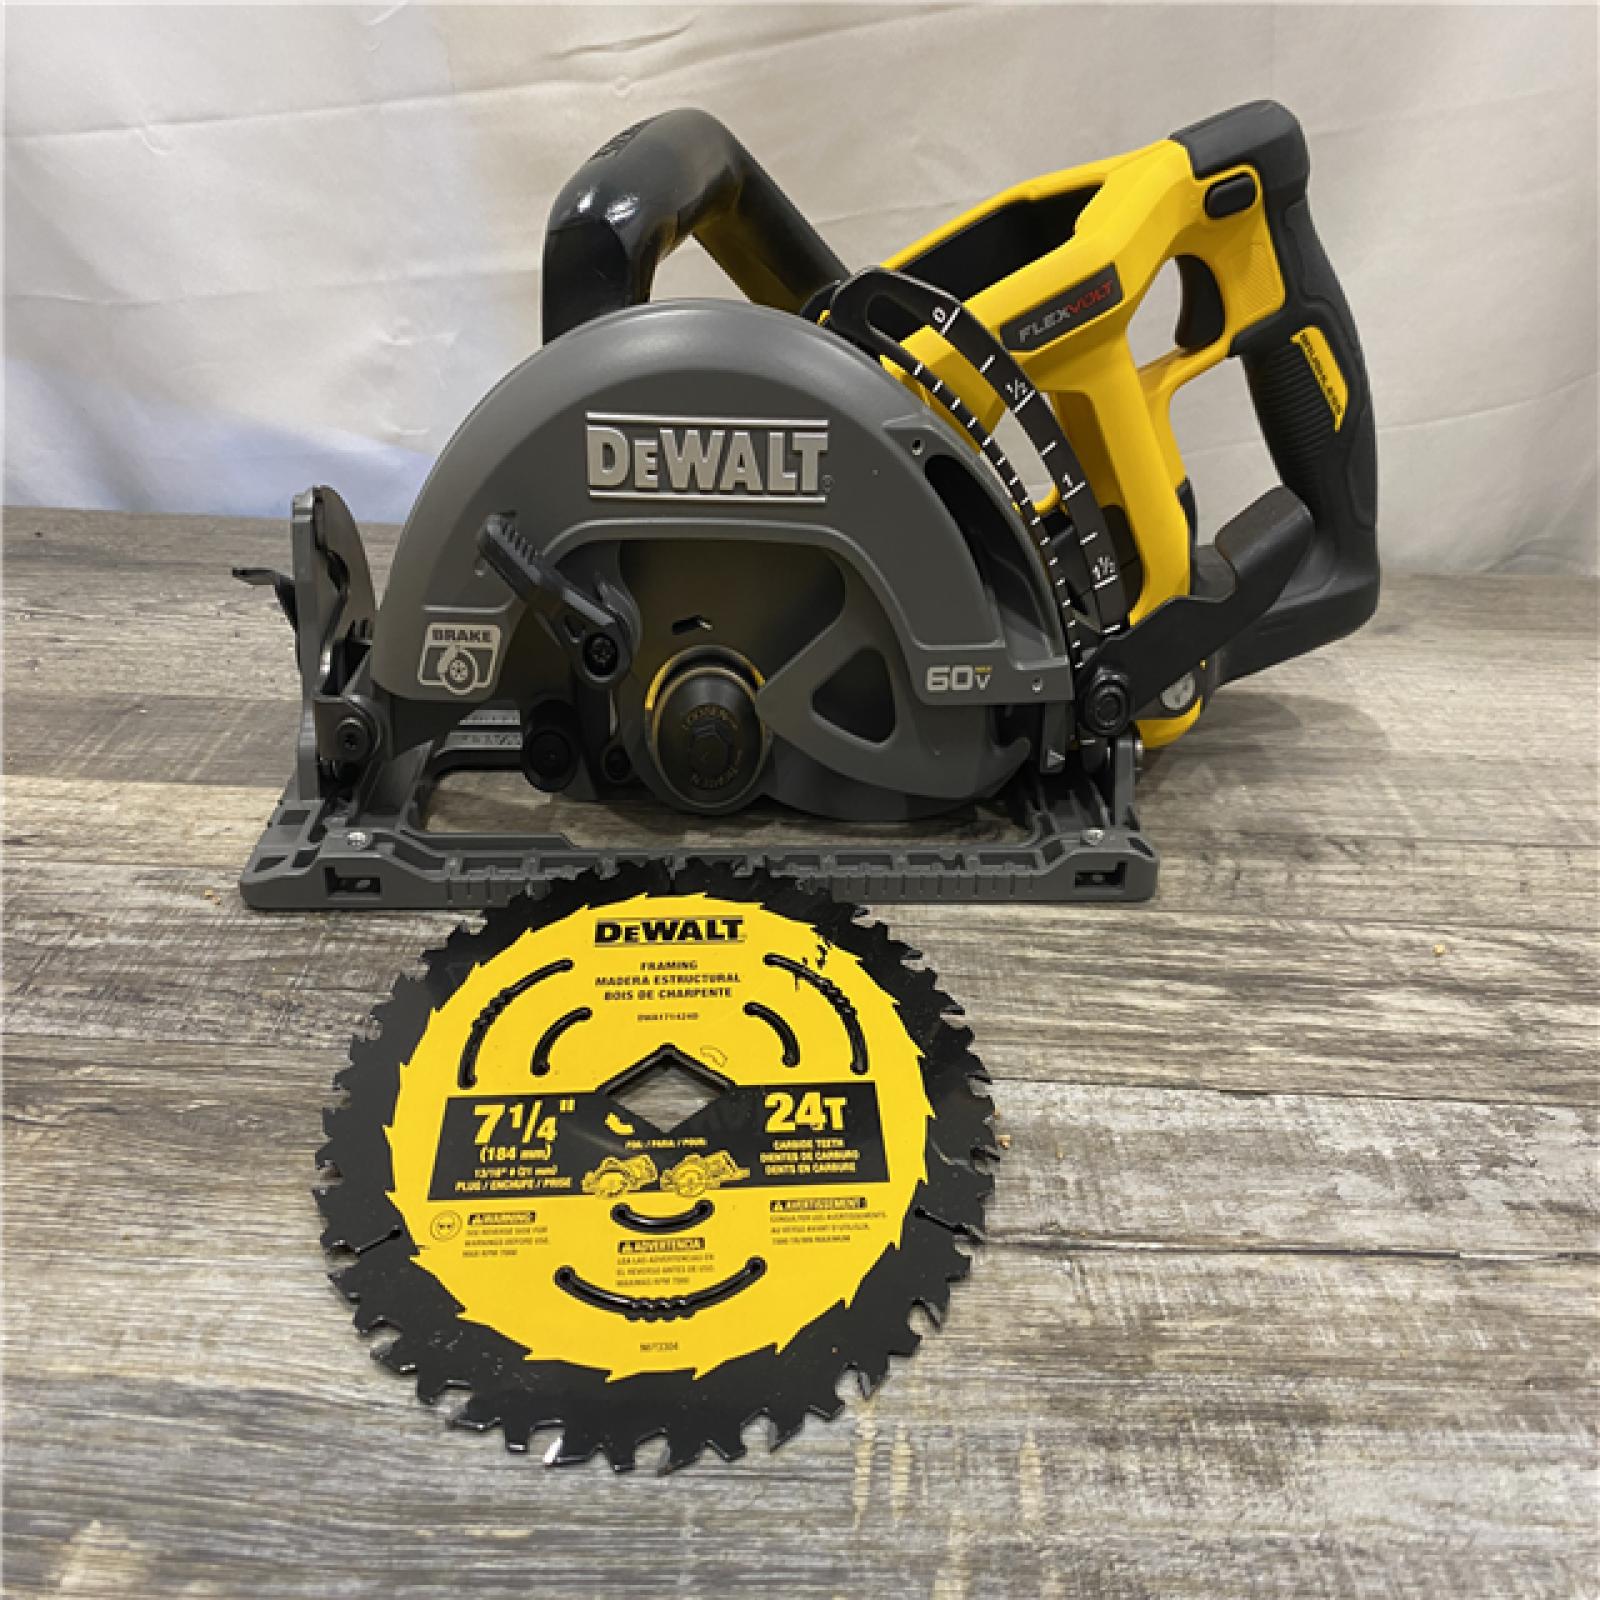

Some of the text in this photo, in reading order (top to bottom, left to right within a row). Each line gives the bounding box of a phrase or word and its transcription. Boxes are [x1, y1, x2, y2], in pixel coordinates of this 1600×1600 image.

[1019, 280, 1113, 344] FLEXVOLT
[586, 424, 829, 494] DEWALT
[431, 628, 492, 643] BRAKE
[595, 919, 744, 943] DEWALT
[640, 960, 698, 971] FRAMING
[595, 973, 741, 986] MADERA ESTRUCTURAL
[604, 987, 732, 1001] BOIS DE CHARPENTE
[764, 1091, 848, 1133] 24T
